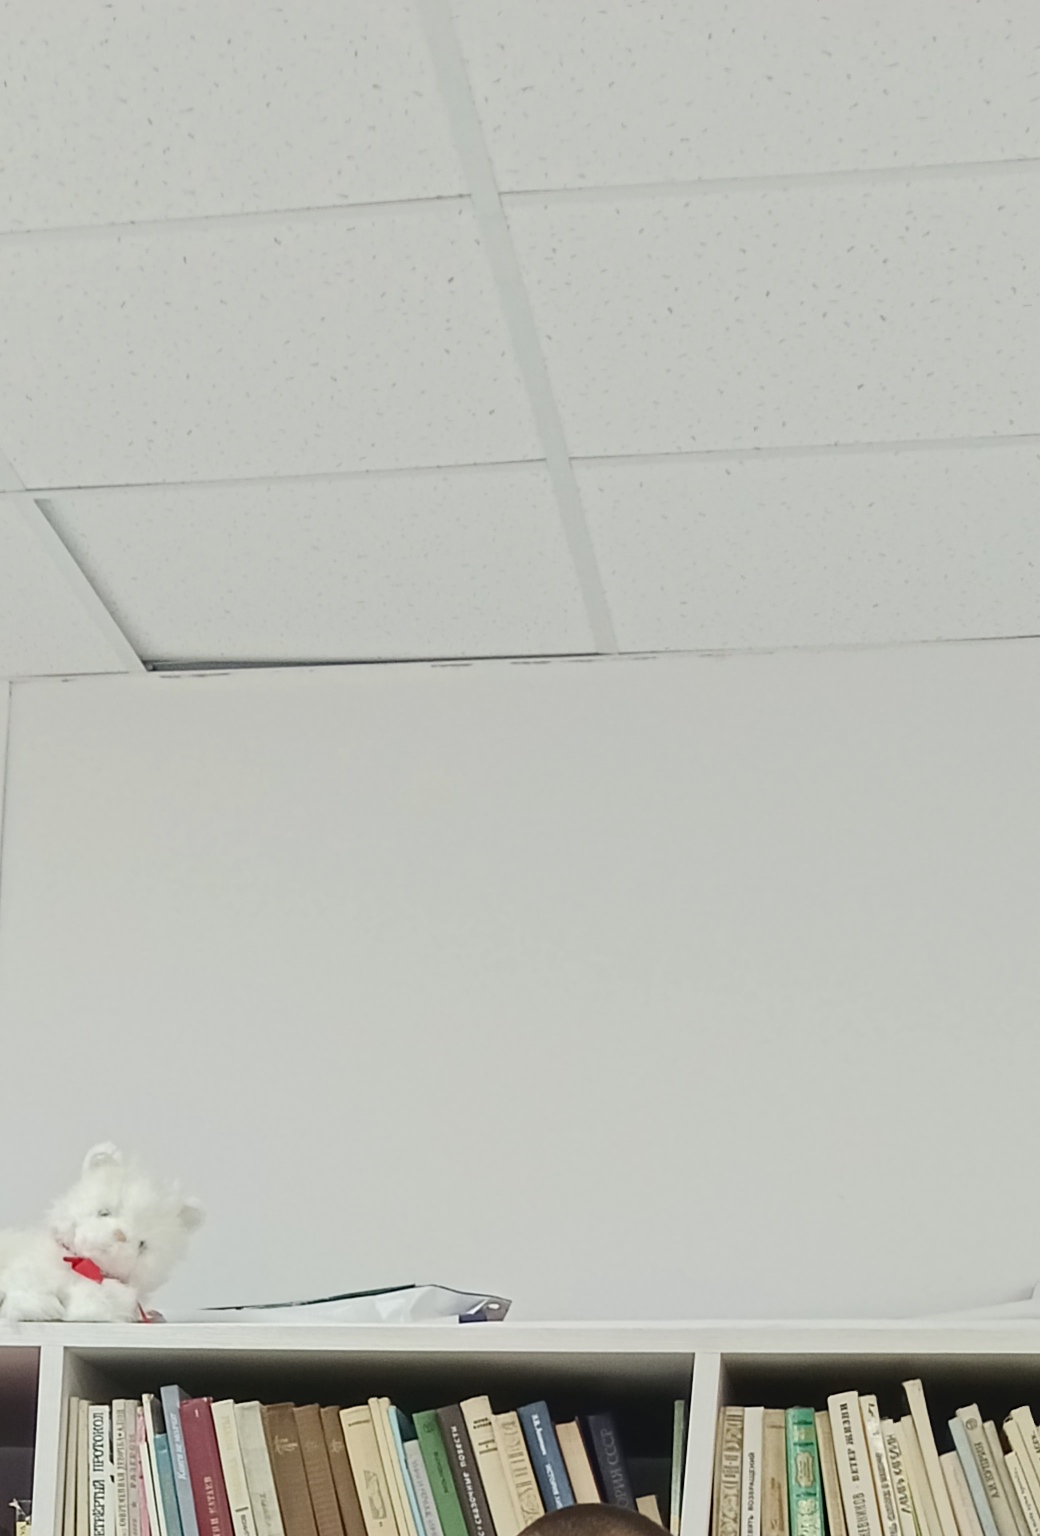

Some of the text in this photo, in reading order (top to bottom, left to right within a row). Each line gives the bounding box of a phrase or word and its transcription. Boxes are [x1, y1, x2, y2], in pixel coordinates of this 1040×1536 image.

[93, 1412, 104, 1472] ПРОТОКОЛ
[839, 1402, 853, 1446] ЖИЗНИ
[600, 1427, 619, 1466] СССР
[845, 1447, 861, 1482] ВЕТЕР
[203, 1475, 216, 1514] КАТАЕВ
